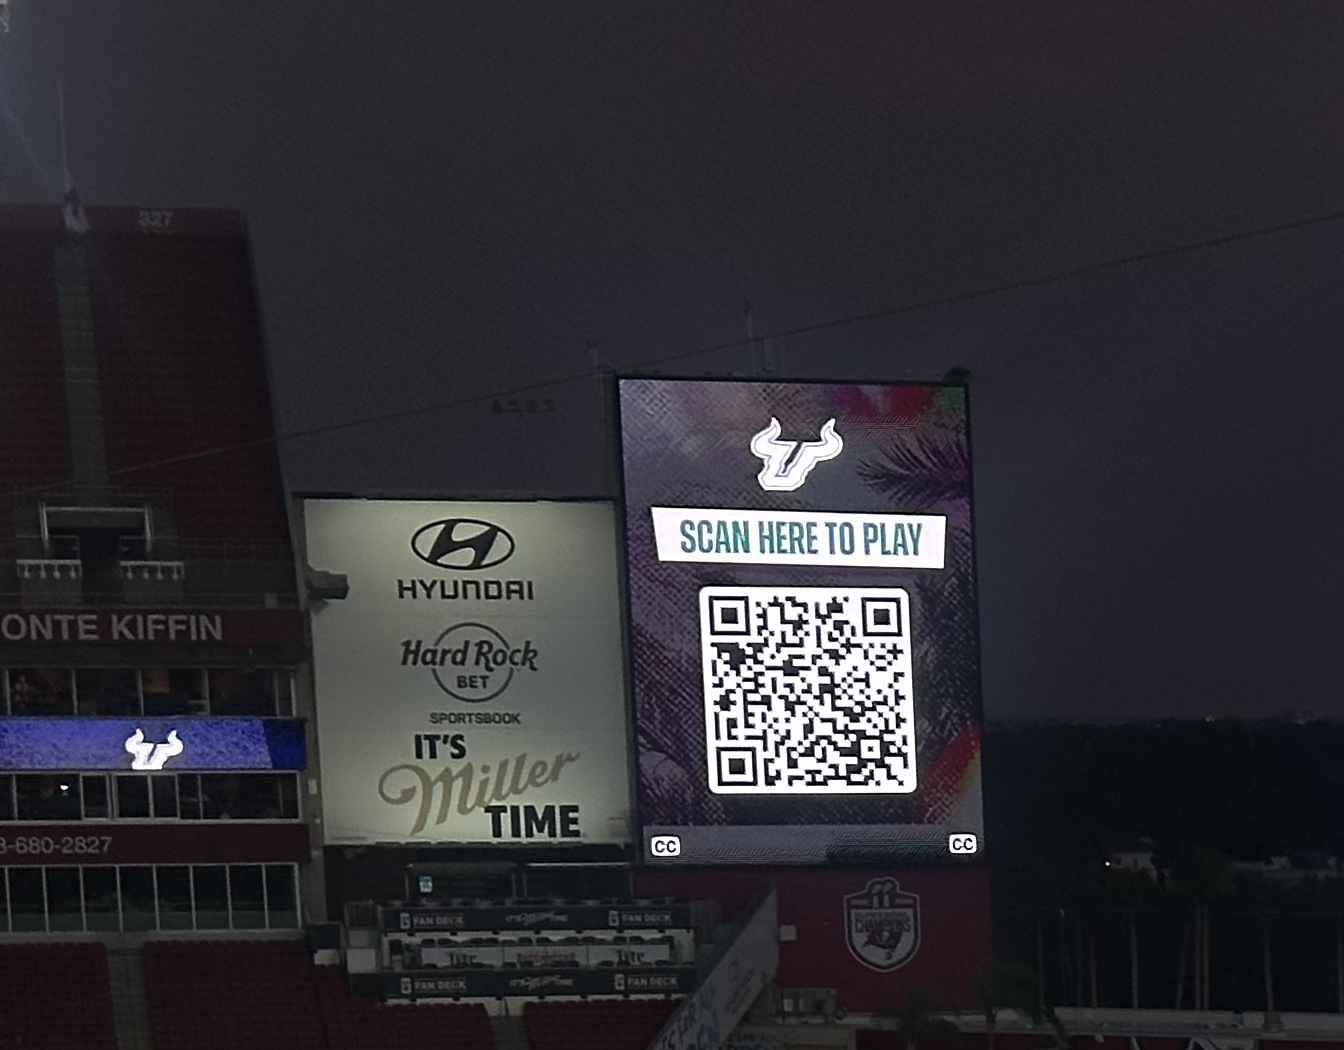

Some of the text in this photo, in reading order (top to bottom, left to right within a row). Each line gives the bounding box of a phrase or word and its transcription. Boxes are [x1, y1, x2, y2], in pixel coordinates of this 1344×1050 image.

[680, 519, 923, 556] SCAN HERE TO PLAY
[397, 579, 534, 600] HYUNDAI
[111, 613, 223, 641] KIFFIN
[401, 639, 538, 671] Hard Rock
[456, 675, 490, 689] BET
[430, 712, 521, 724] SPORTSBOOK
[414, 734, 467, 760] IT'S
[378, 752, 581, 836] Miller
[484, 804, 581, 838] TIME
[654, 840, 677, 853] CC
[952, 838, 974, 851] CC
